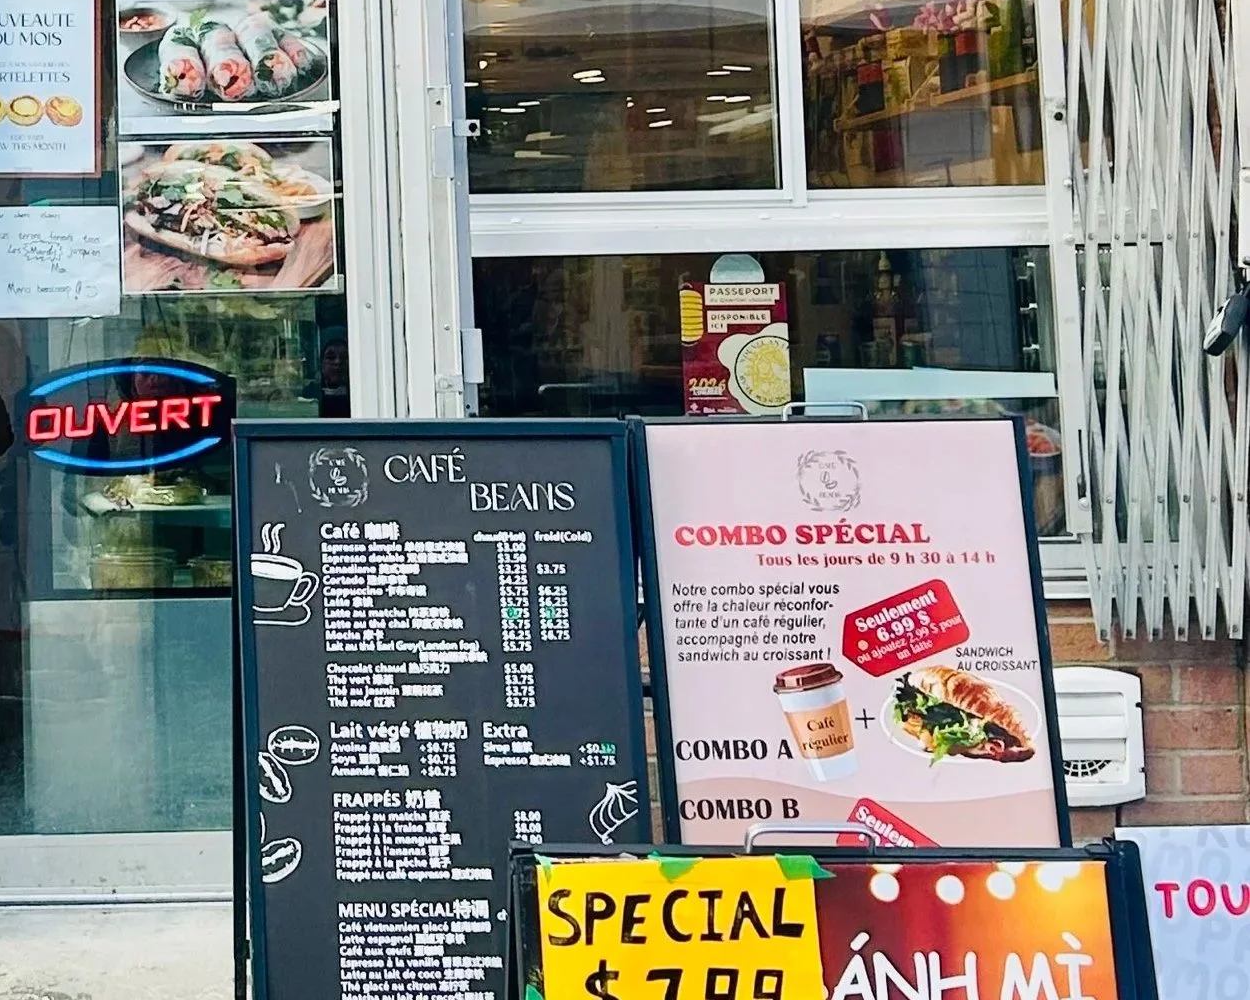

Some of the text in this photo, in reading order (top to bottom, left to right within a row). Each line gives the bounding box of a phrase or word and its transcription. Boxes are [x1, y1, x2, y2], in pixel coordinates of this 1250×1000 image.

[20, 32, 63, 47] MOIS
[710, 287, 774, 295] PASSEPORT
[711, 313, 767, 321] DISPONIBLE
[29, 394, 223, 441] OUVERT
[384, 447, 467, 483] CAFÉ
[470, 482, 575, 512] BEANS
[320, 522, 361, 539] Café
[534, 531, 593, 543] froid(Cold)
[674, 518, 931, 547] COMBO SPÉCIAL
[757, 550, 996, 568] Tous les jours de 9 h 30 à 14 h
[536, 563, 566, 574] $3.75
[499, 585, 568, 596] $5.75 $6.25
[672, 581, 840, 599] Notre combo spécial vous
[673, 598, 834, 613] offre la chaleur réconfor-
[855, 589, 940, 632] Seulement
[675, 614, 827, 631] tante d'un café régulier,
[876, 617, 916, 643] 6.99
[676, 631, 817, 647] accompagné de notre
[857, 651, 871, 664] ou
[872, 637, 907, 662] ajoutez
[906, 626, 929, 645] 2.99
[940, 614, 964, 633] pour
[912, 639, 934, 656] latte
[678, 648, 740, 662] sandwich
[743, 650, 759, 662] au
[762, 648, 823, 661] croissant
[955, 646, 1014, 658] SANDWICH
[326, 663, 372, 674] Chocolat
[375, 662, 407, 673] chaud
[504, 663, 534, 674] $5.00
[957, 660, 1039, 671] AU CROISSANT
[505, 674, 534, 685] $3.75
[506, 696, 536, 707] $3.75
[330, 721, 363, 738] Lait
[367, 721, 410, 742] végé
[483, 722, 528, 738] Extra
[806, 716, 836, 732] Café
[676, 739, 794, 761] COMBO A
[802, 732, 851, 751] régulier
[579, 755, 616, 766] +$1.75
[333, 790, 400, 808] FRAPPÉS
[679, 798, 800, 820] COMBO B
[1154, 879, 1250, 918] TOU
[338, 902, 387, 918] MENU
[548, 887, 805, 946] SPECIAL
[821, 932, 977, 1000] ÁNH
